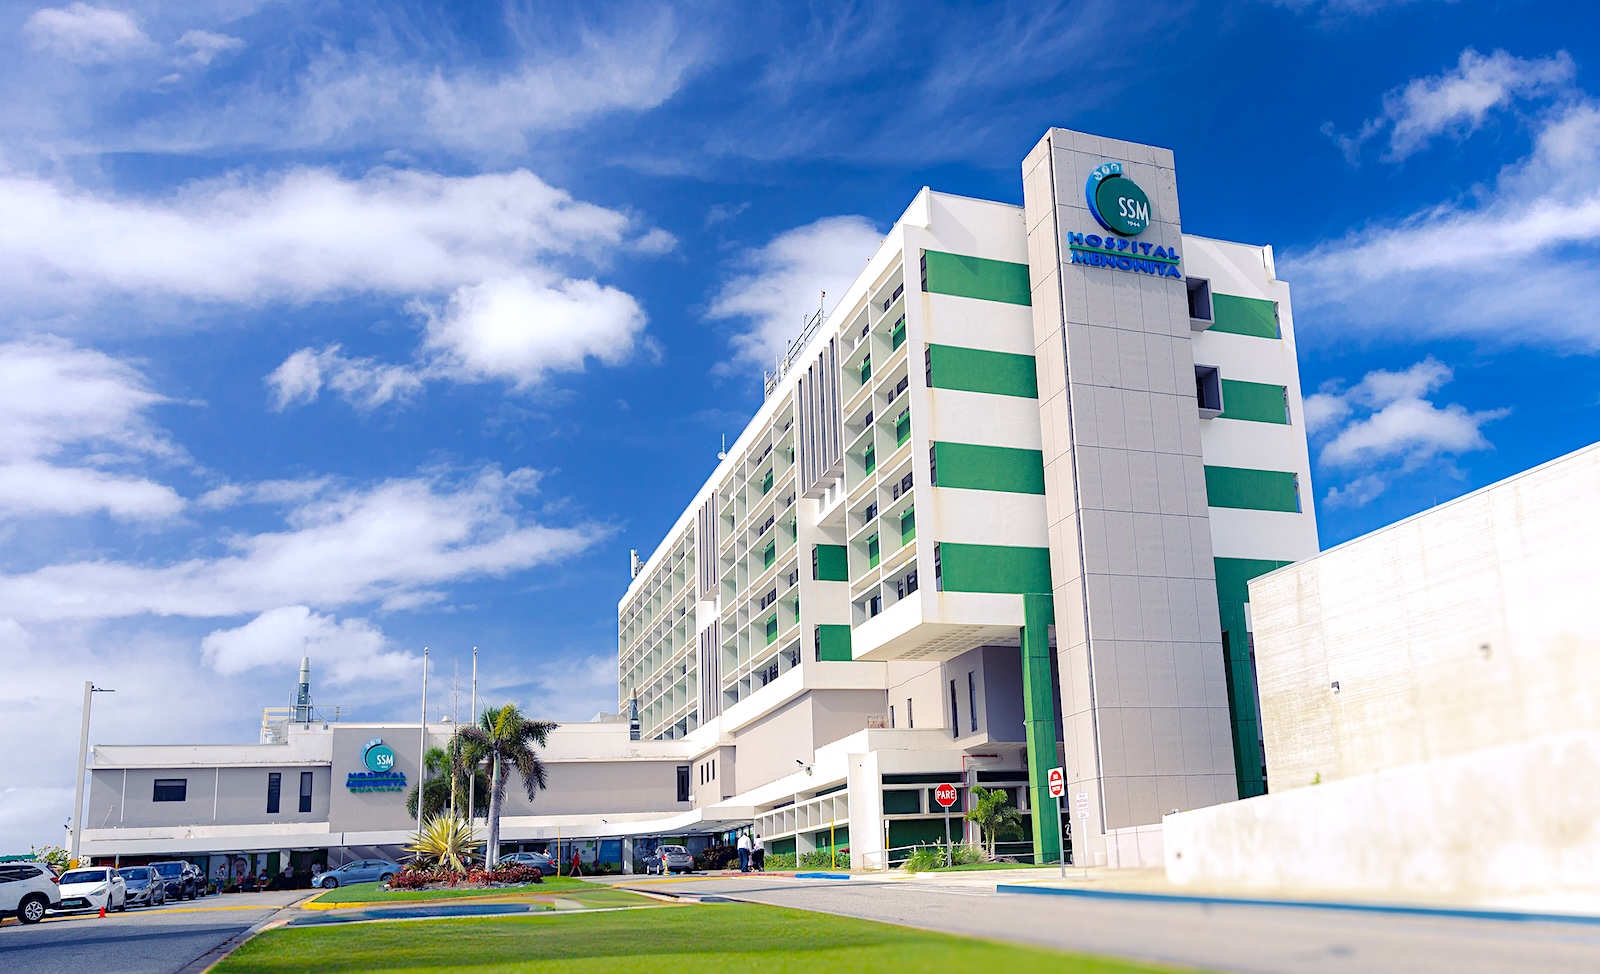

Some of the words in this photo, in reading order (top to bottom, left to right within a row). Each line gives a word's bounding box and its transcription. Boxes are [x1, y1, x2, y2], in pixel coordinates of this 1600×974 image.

[1118, 196, 1150, 227] SSM
[1067, 231, 1180, 260] HOSPITAL
[1070, 250, 1181, 279] MENONITA
[376, 754, 393, 766] SSM
[937, 790, 955, 799] PARE
